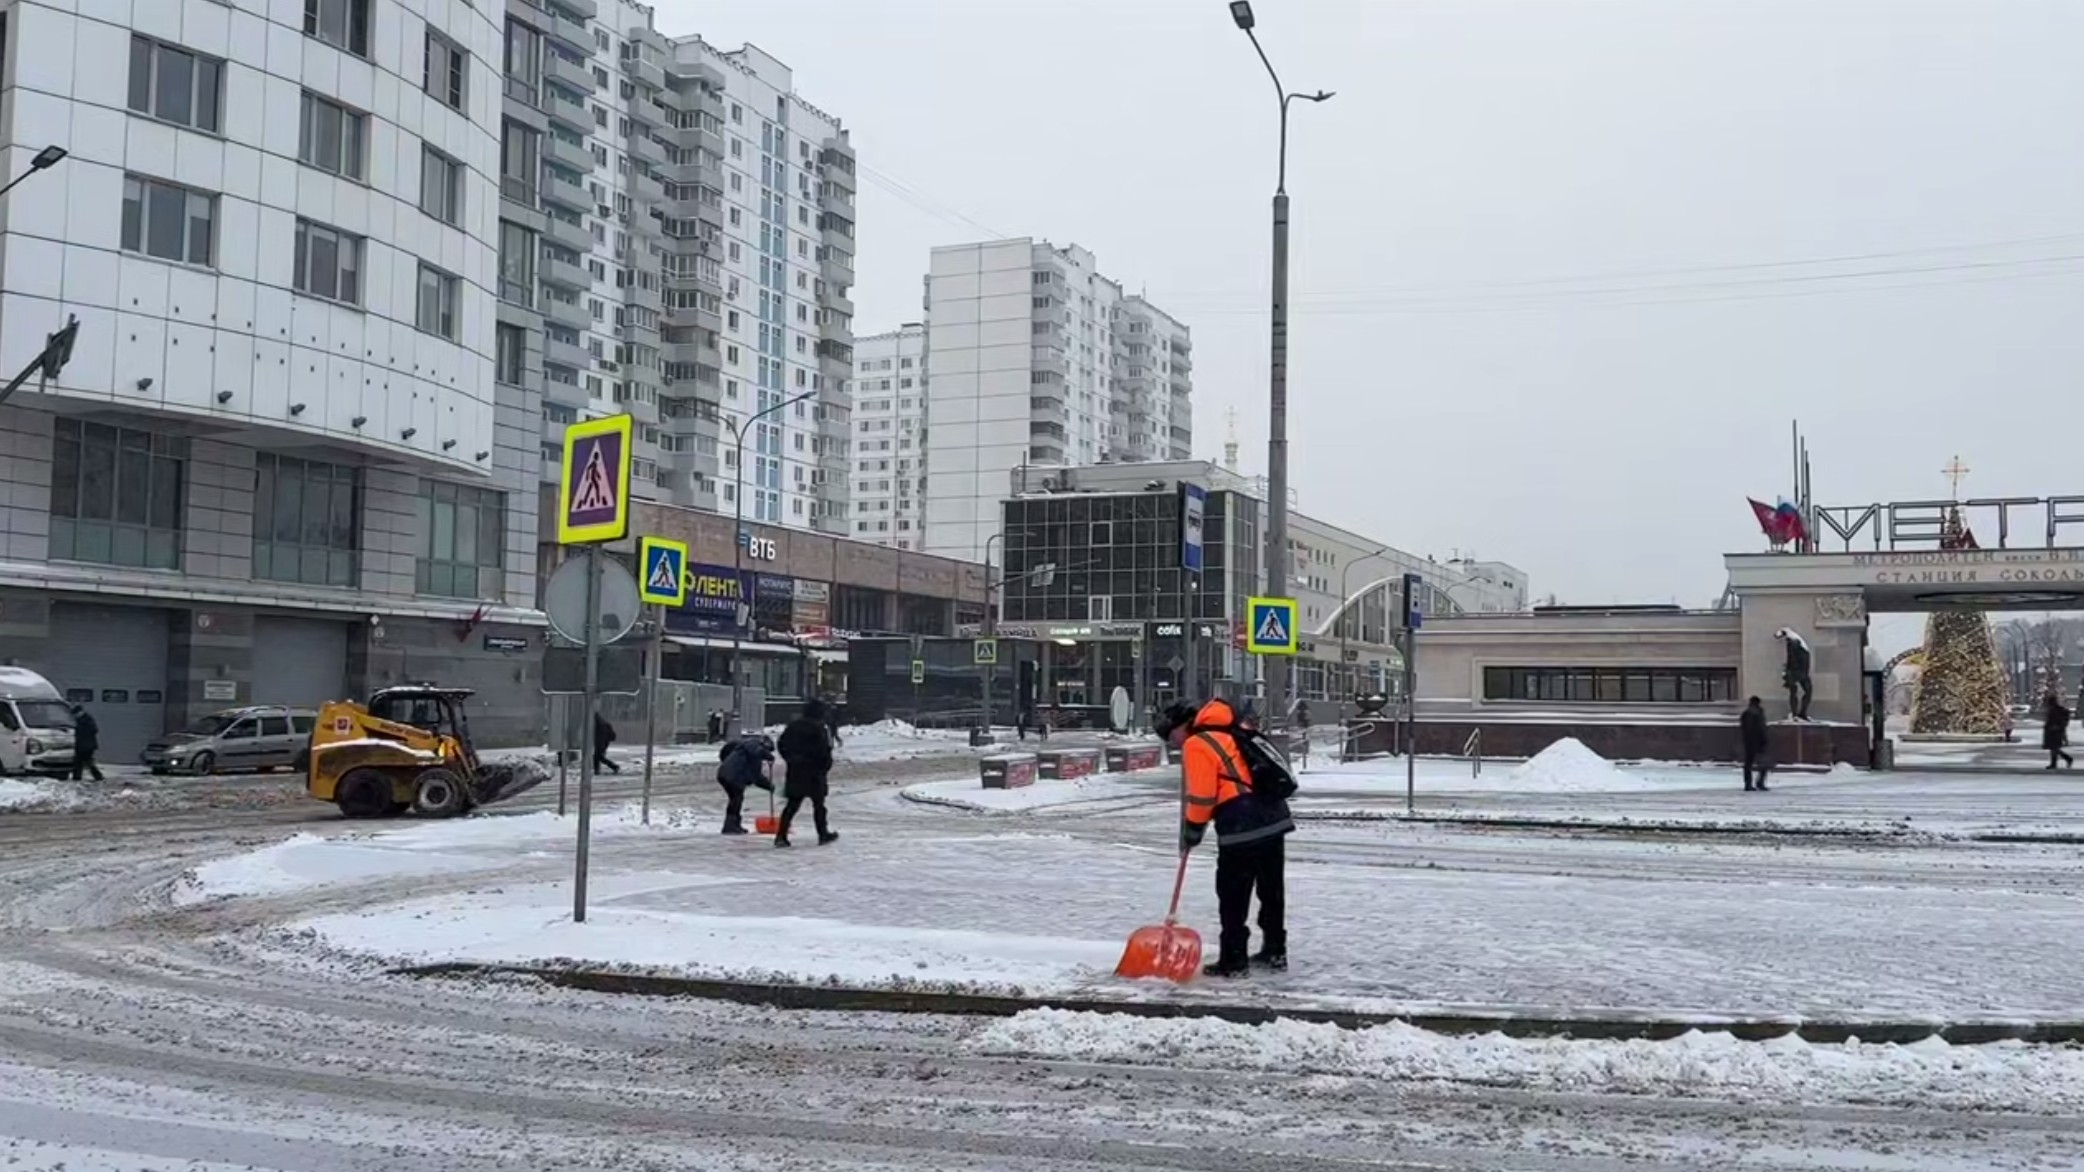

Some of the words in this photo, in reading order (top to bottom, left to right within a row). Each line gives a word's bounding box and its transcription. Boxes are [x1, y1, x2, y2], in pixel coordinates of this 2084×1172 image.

[750, 536, 776, 560] ВТБ
[1853, 551, 1994, 566] МЕТРОПОЛИТЕН
[1876, 570, 1978, 583] СТАНЦИЯ
